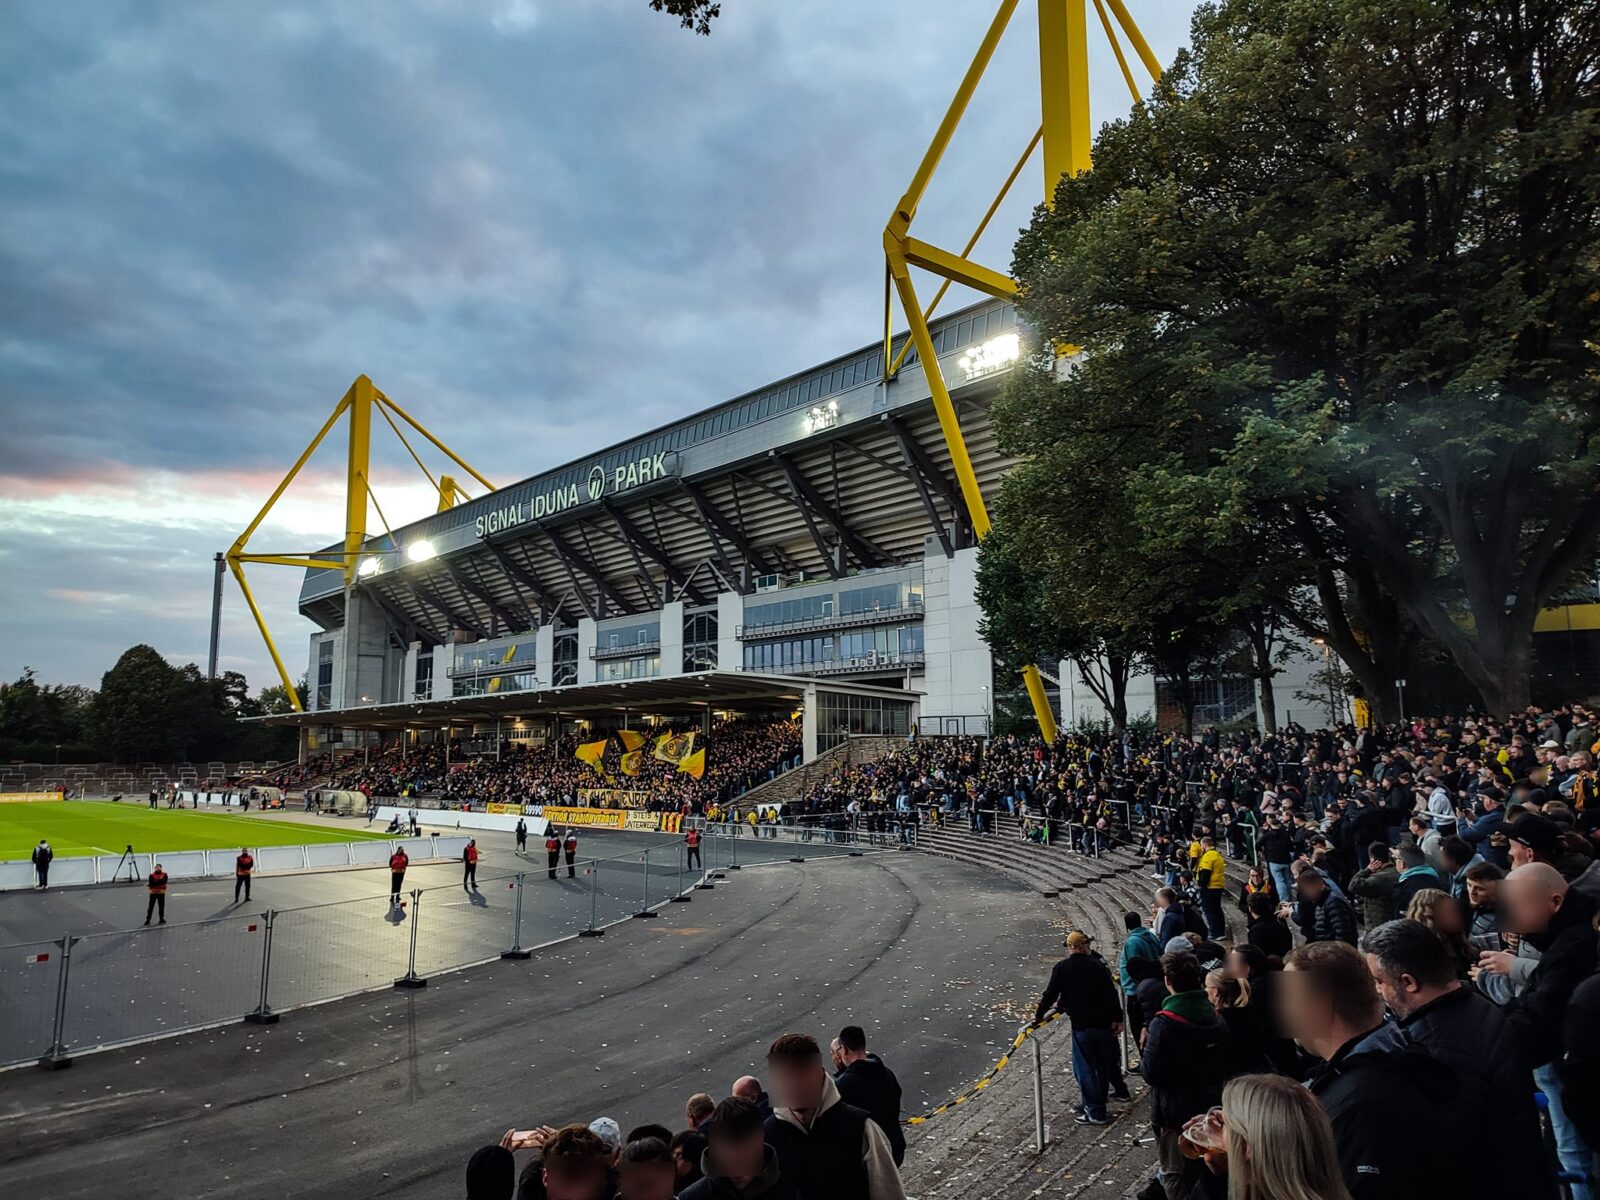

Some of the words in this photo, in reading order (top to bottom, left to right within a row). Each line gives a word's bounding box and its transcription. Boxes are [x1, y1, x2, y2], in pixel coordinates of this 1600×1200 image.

[475, 503, 526, 538] SIGNAL
[530, 483, 580, 520] IDUNA
[615, 452, 667, 491] PARK
[633, 811, 652, 819] STETS
[625, 820, 659, 829] UNTERWEGS
